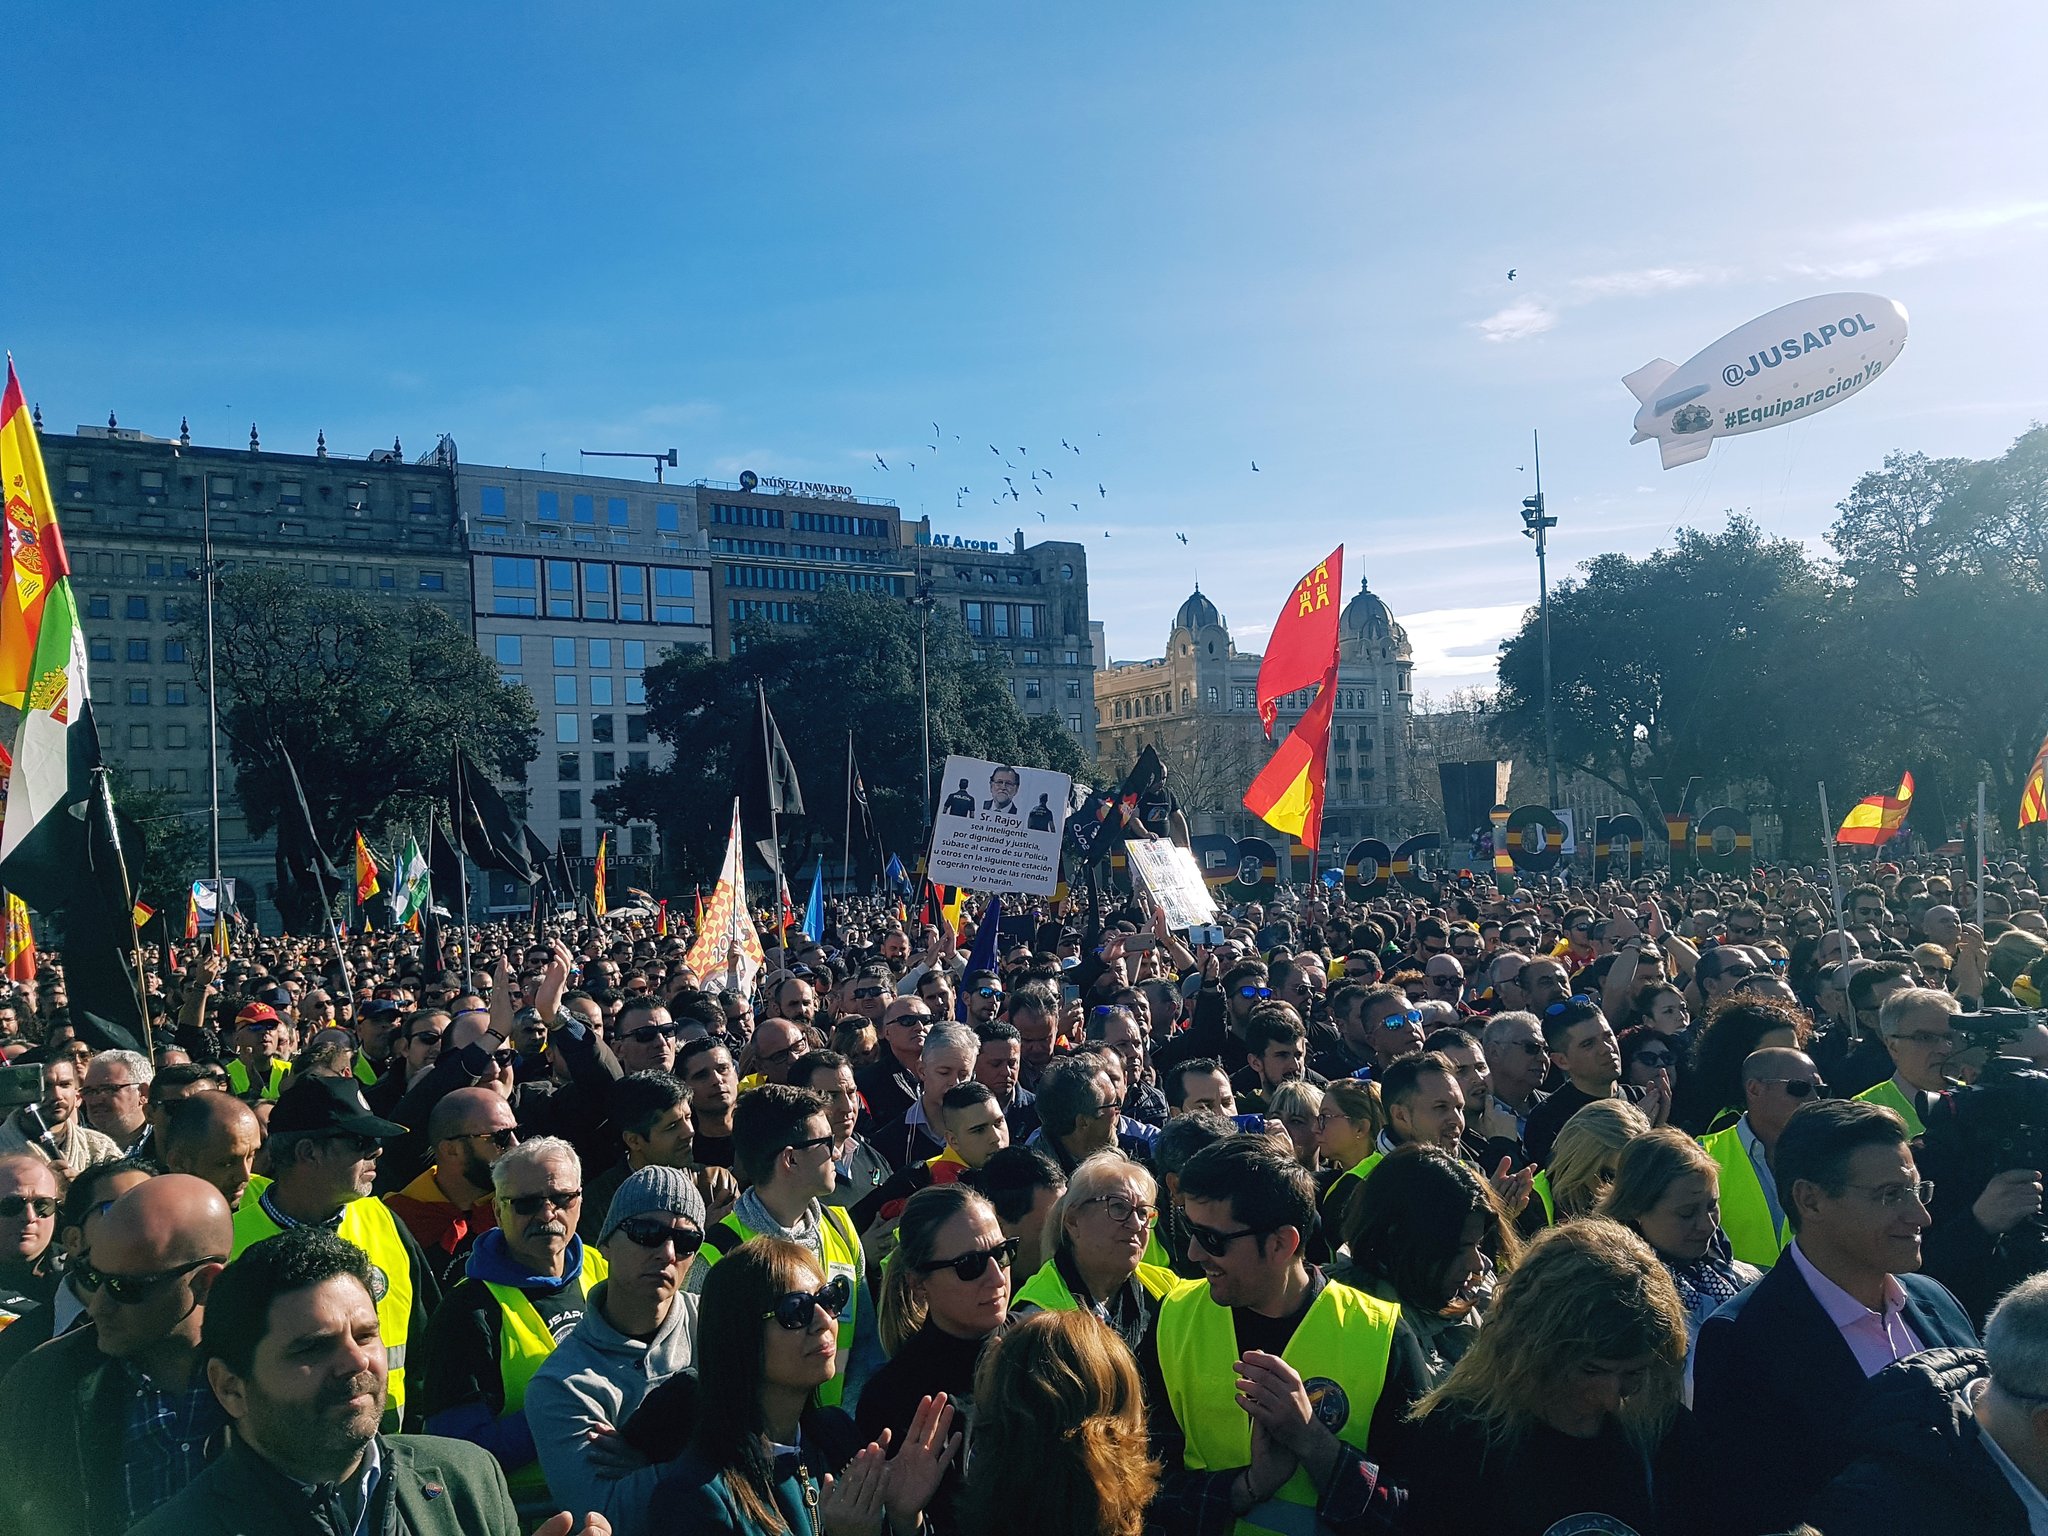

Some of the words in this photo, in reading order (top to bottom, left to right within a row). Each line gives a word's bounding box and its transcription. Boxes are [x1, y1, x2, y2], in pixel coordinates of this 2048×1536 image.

[1722, 313, 1876, 387] @JUSAPOL
[1724, 360, 1883, 429] #EquiparacionYa
[761, 476, 798, 489] NÚÑEZ
[804, 482, 853, 495] NAVARRO
[953, 536, 998, 551] Arona
[980, 813, 992, 822] Sr.
[994, 815, 1023, 828] Rajoy
[985, 825, 1028, 838] inteligente
[953, 831, 968, 839] por
[969, 833, 1004, 845] dignidad
[1011, 840, 1040, 851] justicia,
[980, 846, 1000, 854] carro
[1002, 848, 1012, 856] de
[607, 855, 643, 868] plaza
[941, 849, 961, 858] otros
[984, 856, 1020, 868] siguiente
[1021, 861, 1052, 872] estación
[936, 859, 969, 870] cogerán
[971, 864, 996, 874] relevo
[1009, 869, 1019, 877] las
[1021, 871, 1048, 881] riendas
[979, 874, 987, 882] lo
[988, 877, 1013, 887] harán.
